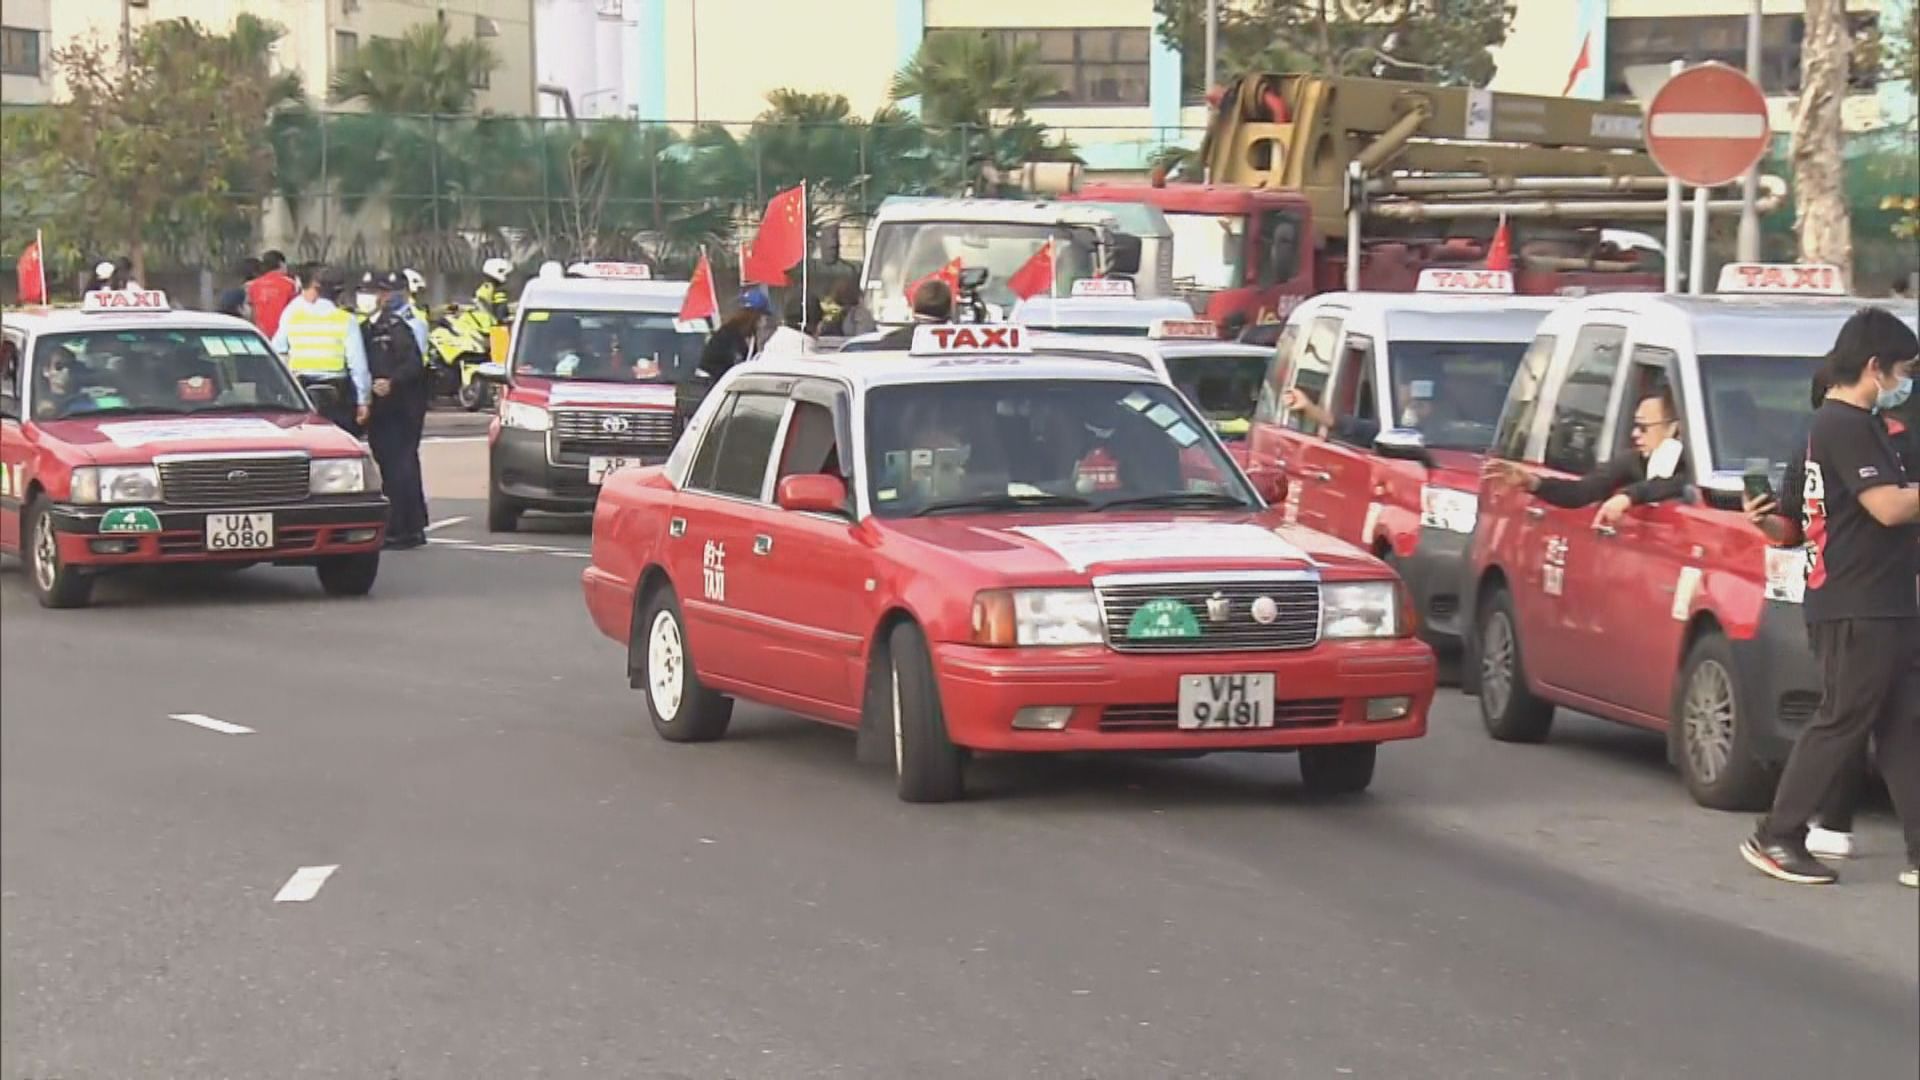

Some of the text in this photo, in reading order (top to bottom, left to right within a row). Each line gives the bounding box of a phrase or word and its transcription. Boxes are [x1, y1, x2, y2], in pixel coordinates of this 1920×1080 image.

[1432, 272, 1505, 288] TAXI
[1739, 266, 1833, 288] TAXI
[95, 292, 160, 307] TAXI
[931, 328, 1019, 348] TAXI
[123, 512, 136, 523] 4
[225, 516, 254, 531] UA
[212, 530, 268, 547] 6080
[704, 539, 725, 569] 的士
[704, 568, 725, 601] TAXI
[1157, 613, 1170, 627] 4
[1209, 676, 1247, 701] VH
[1193, 700, 1260, 728] 9481
